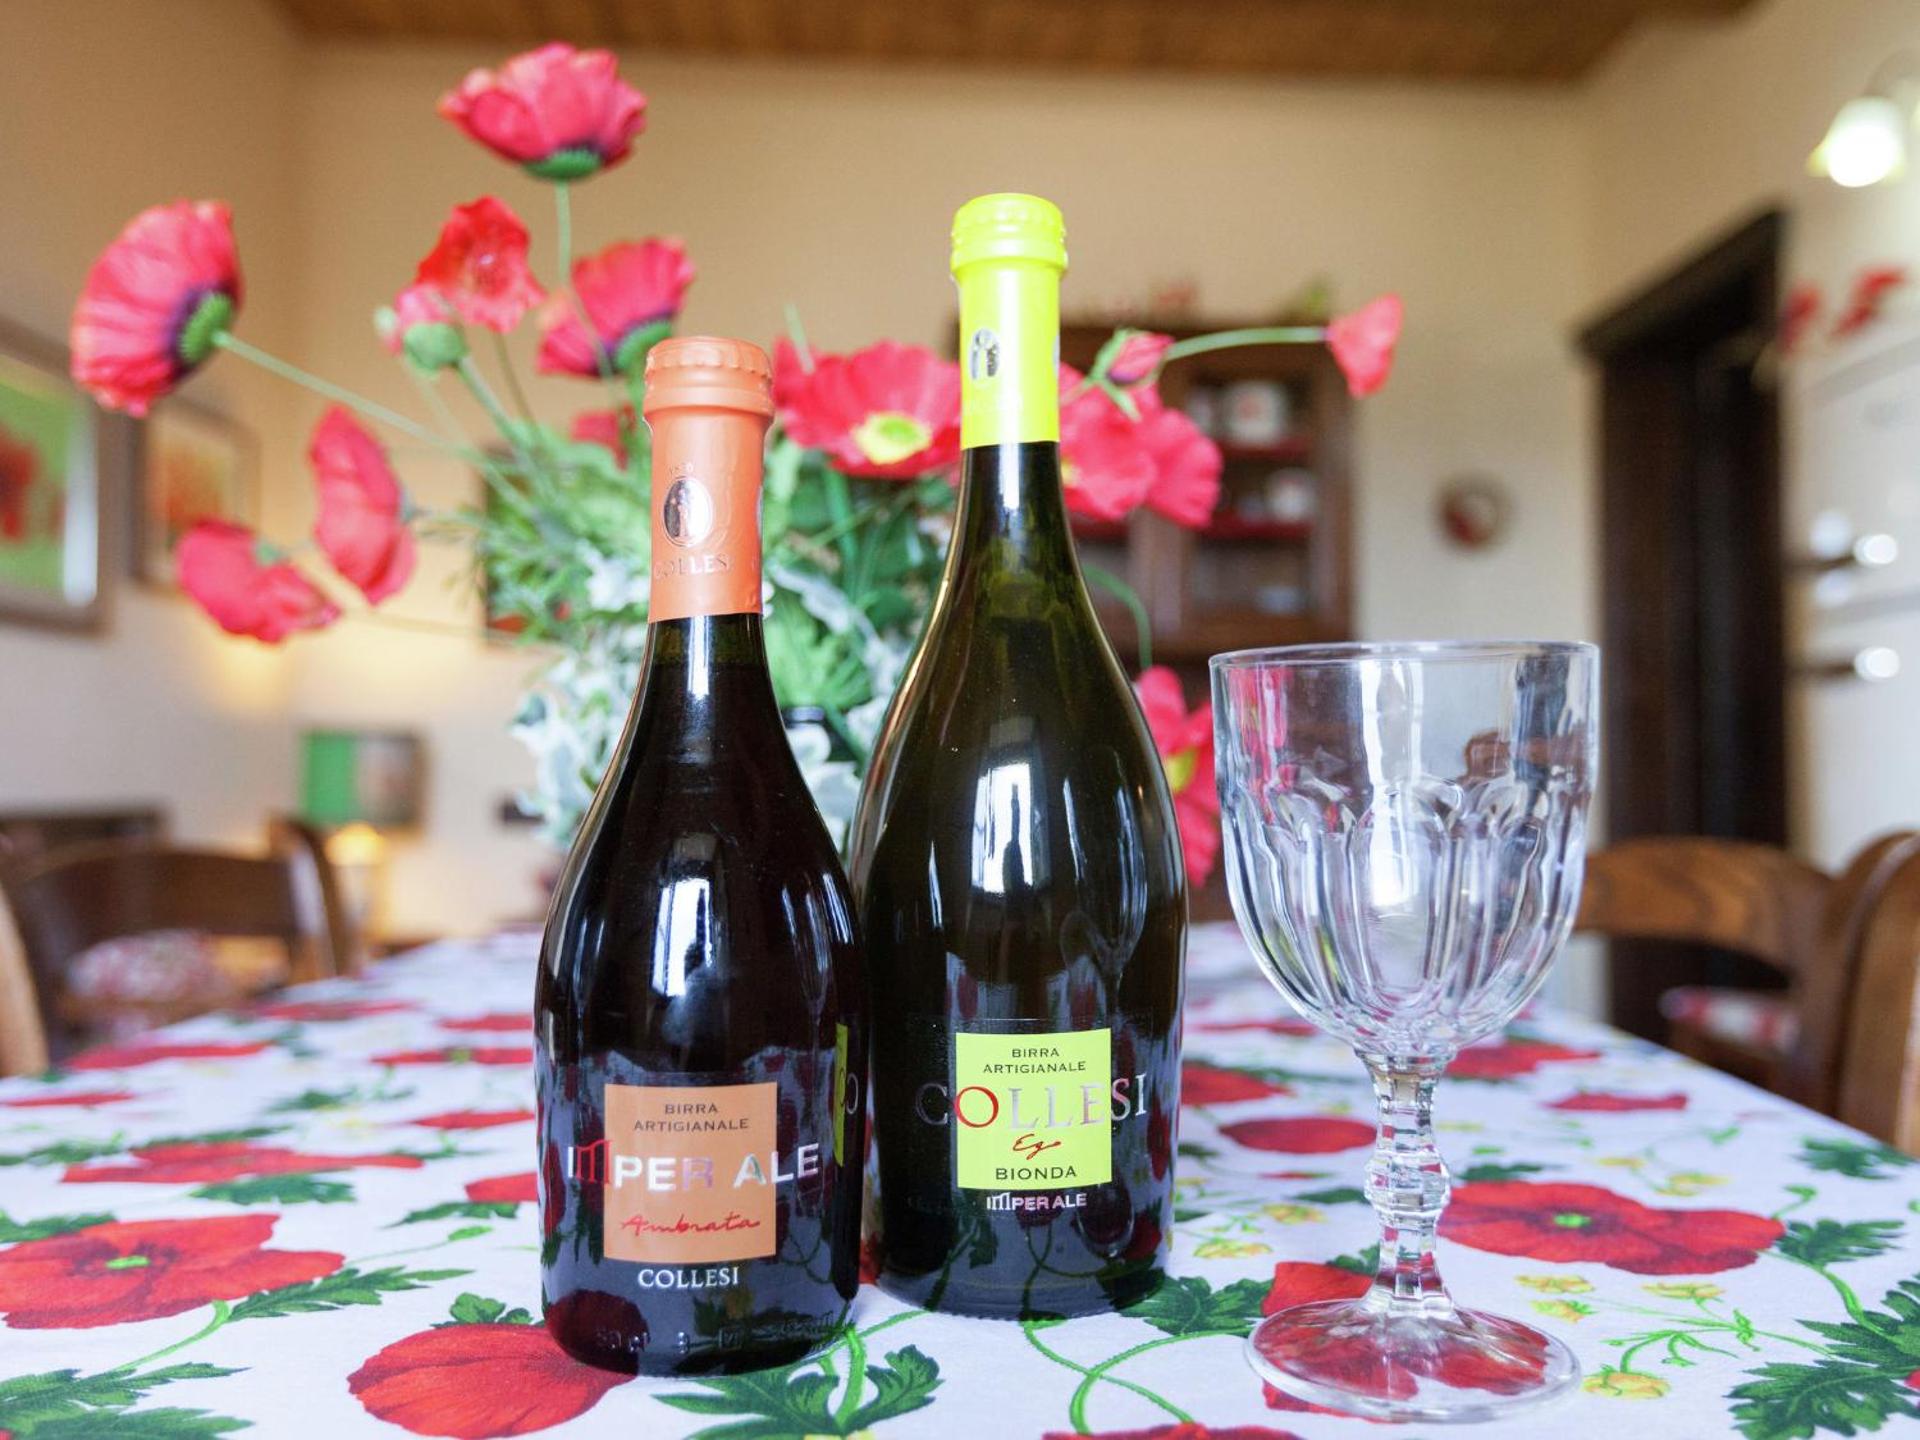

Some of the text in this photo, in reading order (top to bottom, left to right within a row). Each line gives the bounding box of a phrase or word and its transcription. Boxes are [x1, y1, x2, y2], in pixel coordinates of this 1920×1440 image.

[1011, 1047, 1060, 1059] BIRRA
[983, 1061, 1086, 1074] ARTIGIANALE
[663, 1102, 719, 1116] BIRRA
[915, 1073, 1147, 1131] COLLESI
[633, 1118, 750, 1132] ARTIGIANALE
[995, 1167, 1077, 1181] BIONDA
[618, 1211, 761, 1237] Ambrata
[638, 1266, 739, 1289] COLLESI
